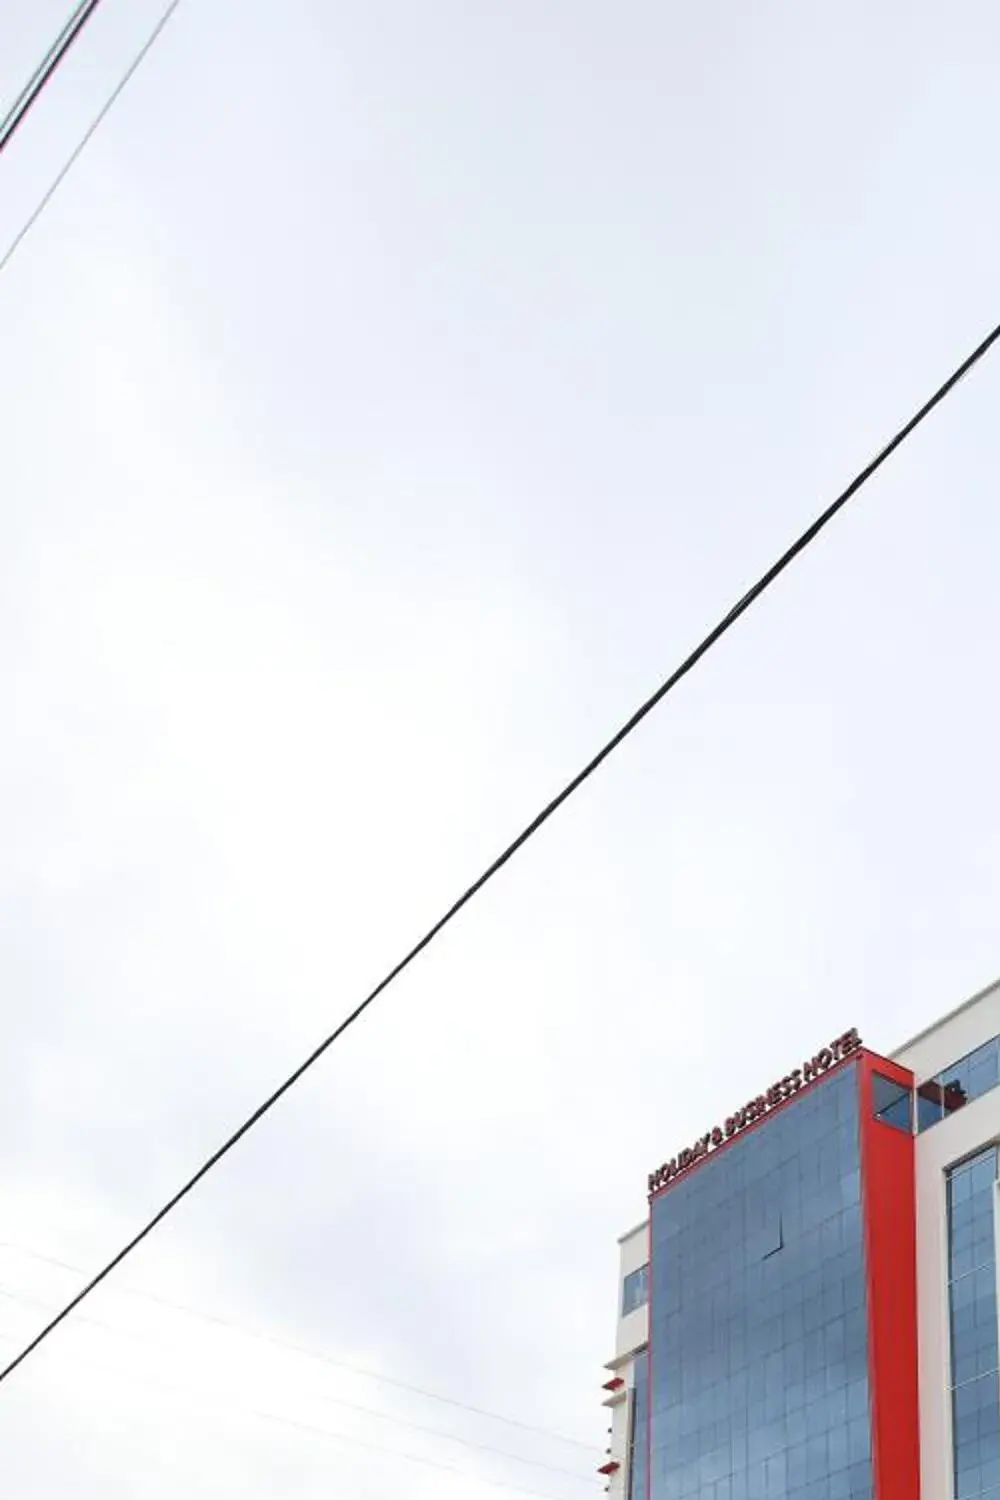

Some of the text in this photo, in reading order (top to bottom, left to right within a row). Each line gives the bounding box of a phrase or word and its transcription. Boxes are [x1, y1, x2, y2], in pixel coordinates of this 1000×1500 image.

[648, 1132, 711, 1191] HOLIDAY
[724, 1069, 802, 1137] BUSINESS
[803, 1027, 863, 1083] HOTEL
